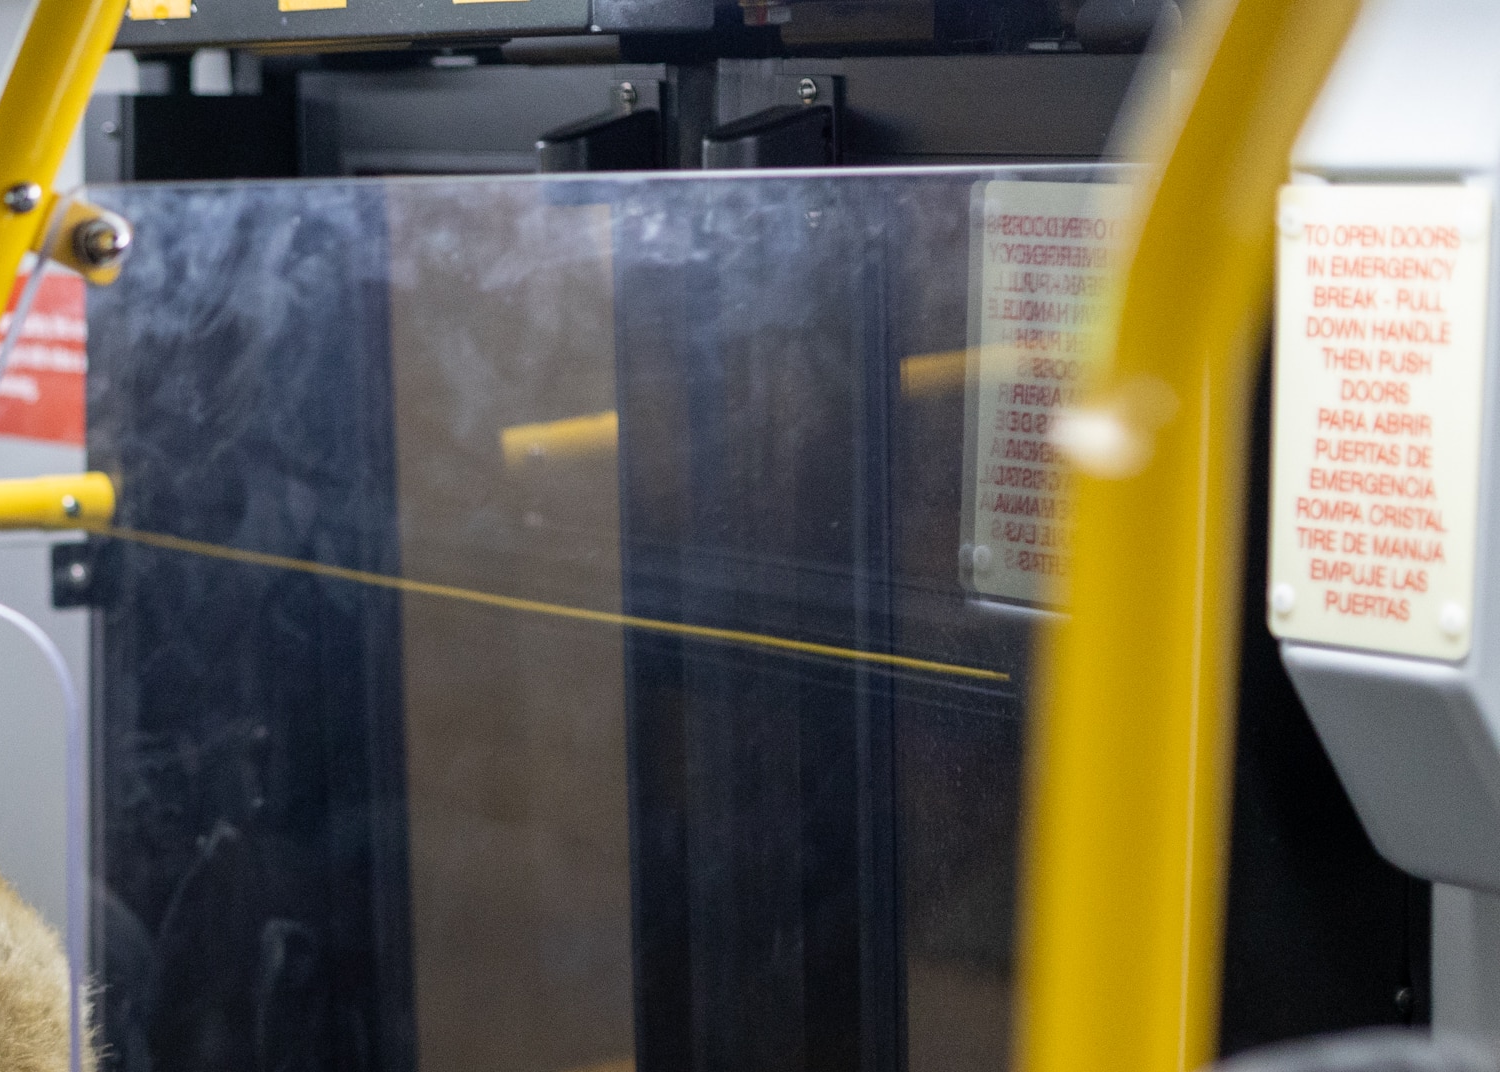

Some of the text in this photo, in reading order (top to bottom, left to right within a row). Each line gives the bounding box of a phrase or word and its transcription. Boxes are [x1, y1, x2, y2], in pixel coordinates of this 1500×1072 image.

[1303, 223, 1461, 250] TO OPEN DOORS
[1306, 255, 1457, 281] IN EMERGENCY
[1312, 285, 1378, 309] BREAK
[1396, 288, 1445, 313] PULL
[1305, 316, 1451, 345] DOWN HANDLE
[1322, 346, 1432, 375] THEN PUSH
[1340, 379, 1411, 405] DOORS
[1317, 407, 1433, 437] PARA ABRIR
[1314, 438, 1432, 469] PUERTAS DE
[1308, 467, 1437, 499] EMERGENCIA
[1296, 496, 1448, 533] ROMPA CRISTAL
[1296, 526, 1446, 563] TIRE DE MANIJA
[1309, 558, 1428, 593] EMPUJE LAS
[1324, 589, 1411, 622] PUERTAS
